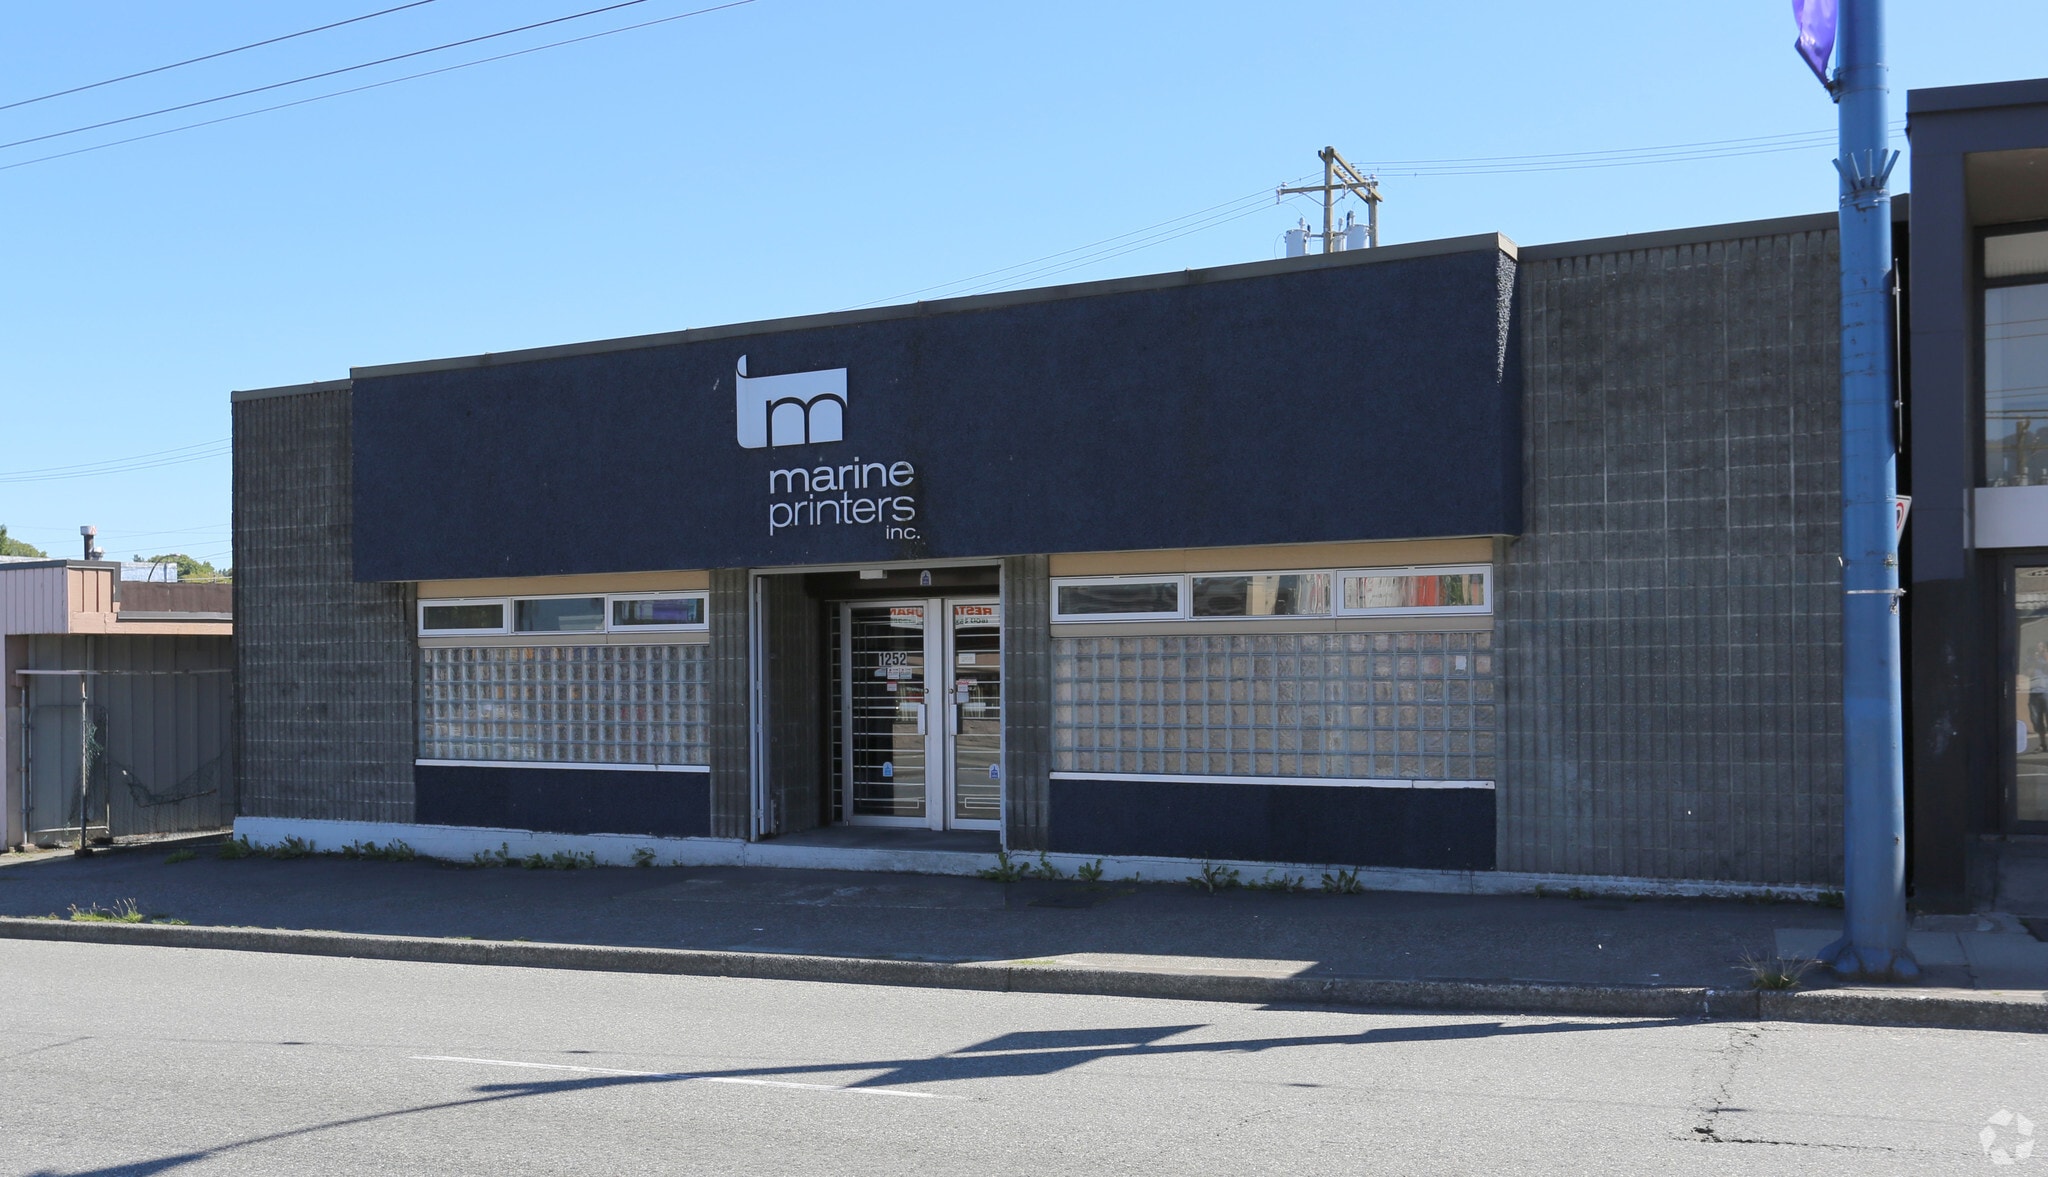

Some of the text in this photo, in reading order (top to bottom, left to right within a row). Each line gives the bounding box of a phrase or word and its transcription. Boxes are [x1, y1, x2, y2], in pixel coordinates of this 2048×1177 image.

[769, 456, 915, 494] marine
[769, 491, 916, 537] printers
[886, 525, 921, 540] inc.
[879, 652, 907, 666] 1252
